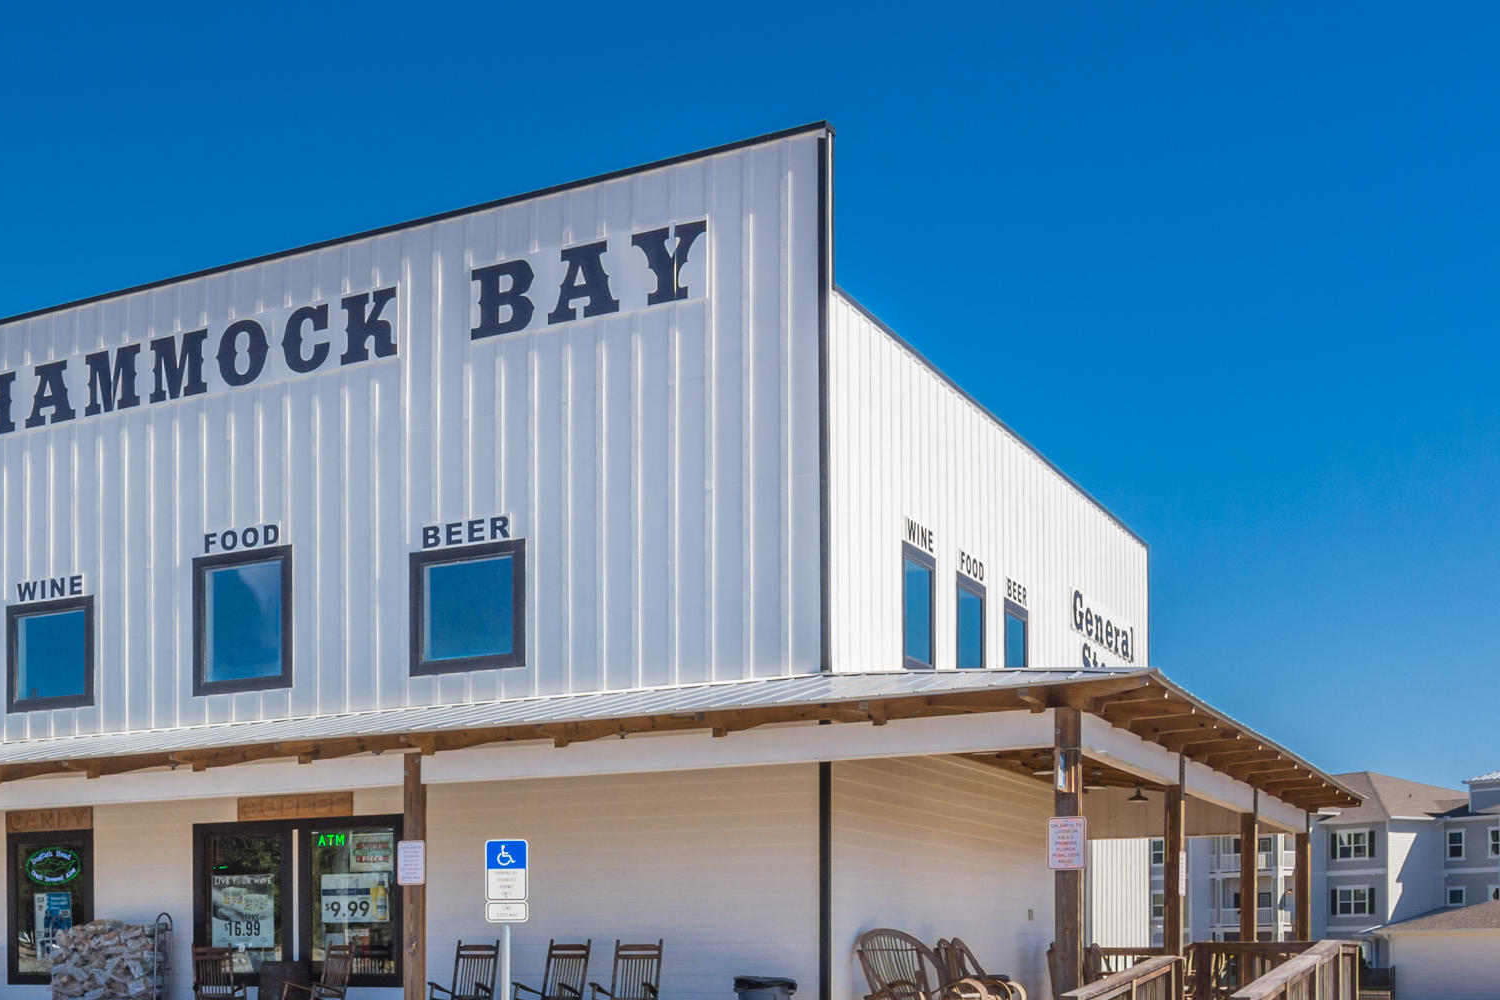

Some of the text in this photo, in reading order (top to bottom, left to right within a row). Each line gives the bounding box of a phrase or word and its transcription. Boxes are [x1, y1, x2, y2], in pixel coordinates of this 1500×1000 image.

[471, 220, 707, 340] BAY
[204, 524, 280, 553] FOOD
[422, 516, 511, 549] BEER
[907, 518, 934, 553] WINE
[960, 551, 984, 582] FOOD
[17, 575, 84, 602] WINE
[1007, 578, 1027, 606] BEER
[1073, 590, 1134, 663] General
[11, 809, 86, 831] CANDY
[318, 834, 345, 847] ATM
[214, 876, 230, 886] LIVE
[253, 876, 272, 885] WAVE
[324, 900, 370, 917] $9.99
[224, 920, 261, 936] $16.99
